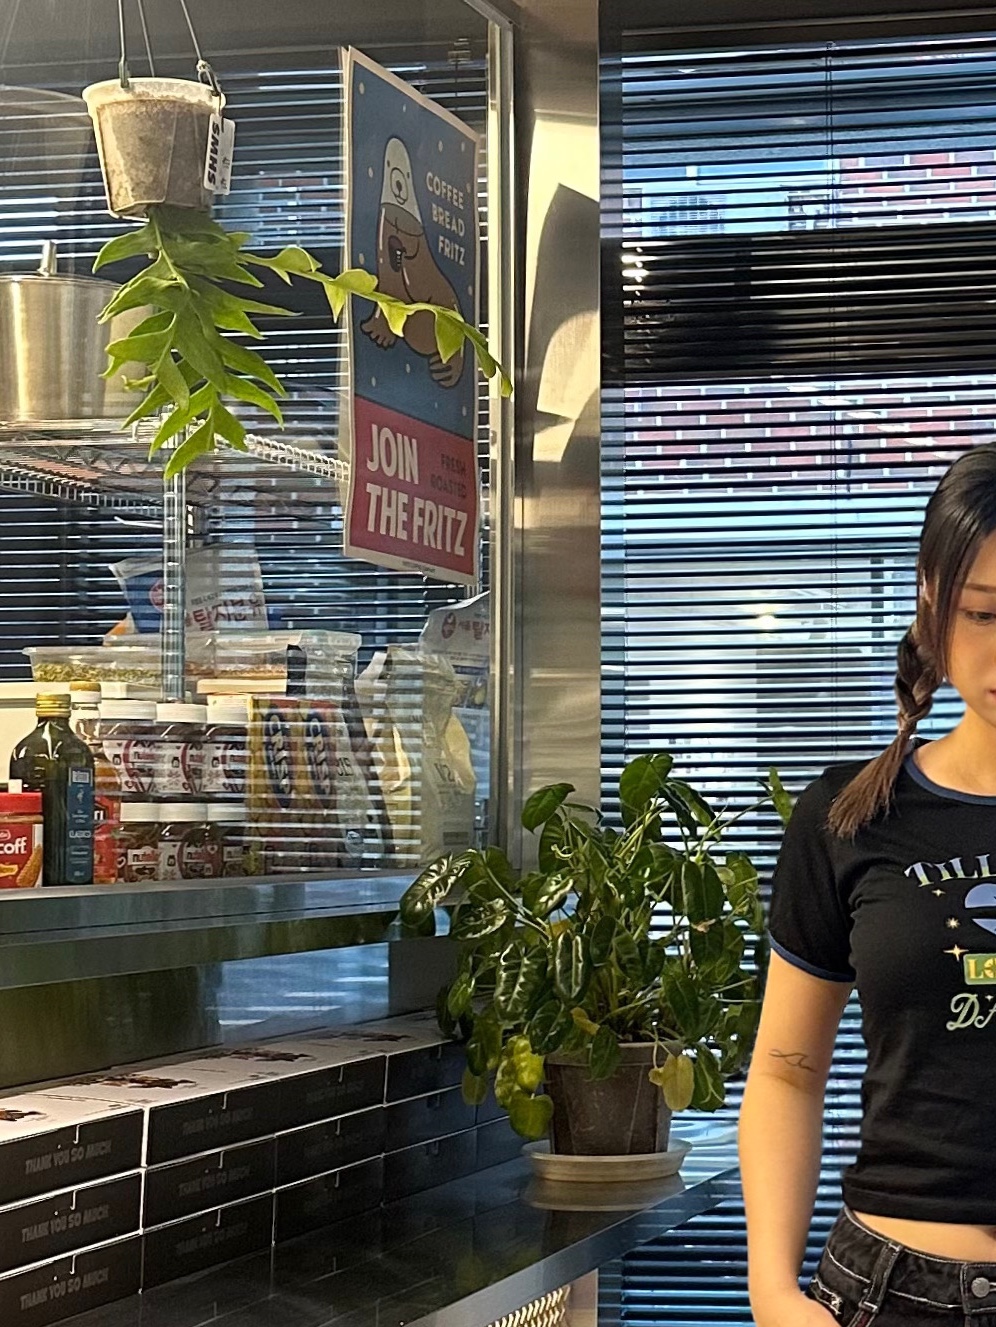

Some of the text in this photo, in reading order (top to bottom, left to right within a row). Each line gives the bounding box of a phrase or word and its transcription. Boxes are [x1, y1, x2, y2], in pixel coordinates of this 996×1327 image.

[425, 171, 464, 210] COFFEE
[431, 203, 465, 237] BREAD
[438, 235, 465, 266] FRITZ
[366, 423, 419, 485] JOIN
[366, 482, 468, 556] THE FRITZ
[25, 1153, 52, 1175] THANK
[53, 1149, 70, 1167] YOU
[71, 1146, 85, 1163] SO
[22, 1220, 49, 1243] THANK
[50, 1215, 67, 1235] YOU
[68, 1211, 82, 1229] SO
[20, 1287, 48, 1311] THANK
[49, 1280, 66, 1300] YOU
[67, 1276, 81, 1293] SO
